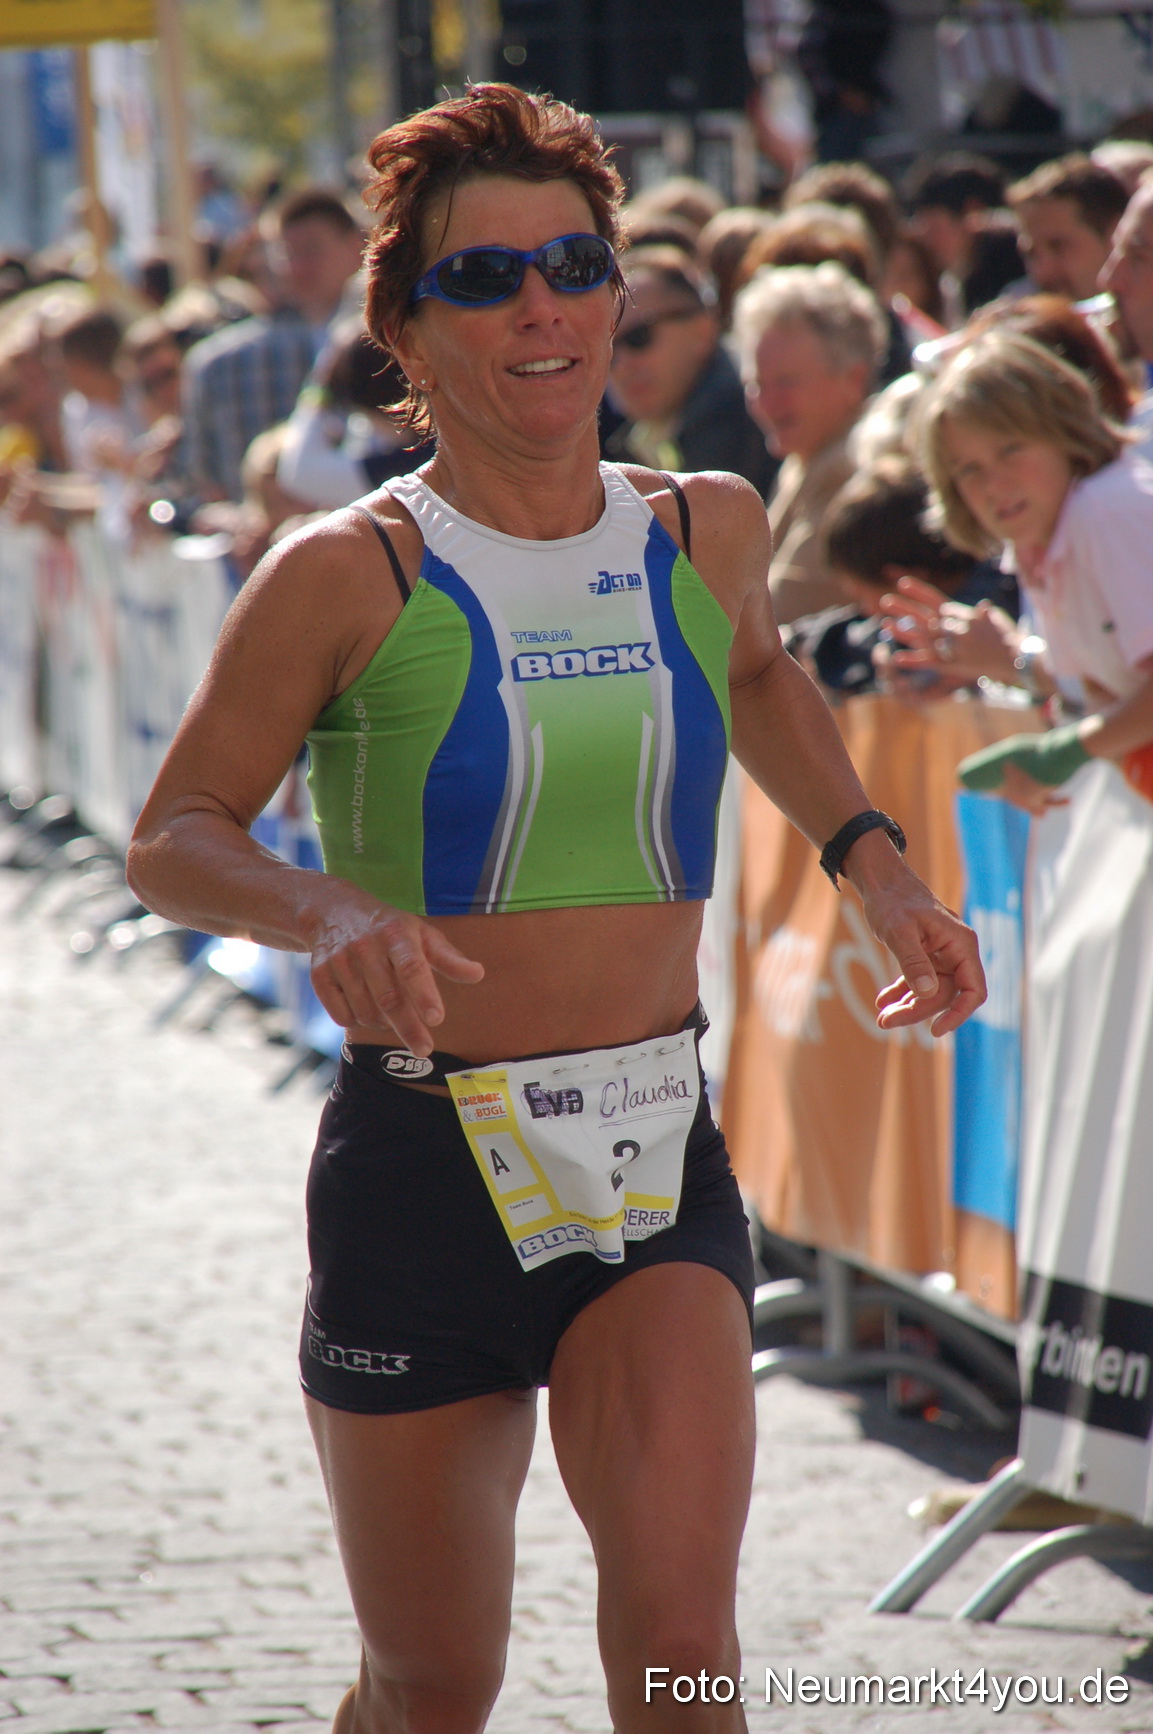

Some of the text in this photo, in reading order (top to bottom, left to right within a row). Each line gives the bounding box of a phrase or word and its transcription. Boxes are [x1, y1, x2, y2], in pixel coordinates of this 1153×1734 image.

[510, 629, 573, 644] TEAM
[510, 642, 656, 682] BOCK
[599, 1074, 693, 1119] Claudia
[490, 1148, 510, 1176] A
[624, 1208, 670, 1226] ERER
[518, 1223, 598, 1259] BOCK
[308, 1335, 411, 1375] BOCK
